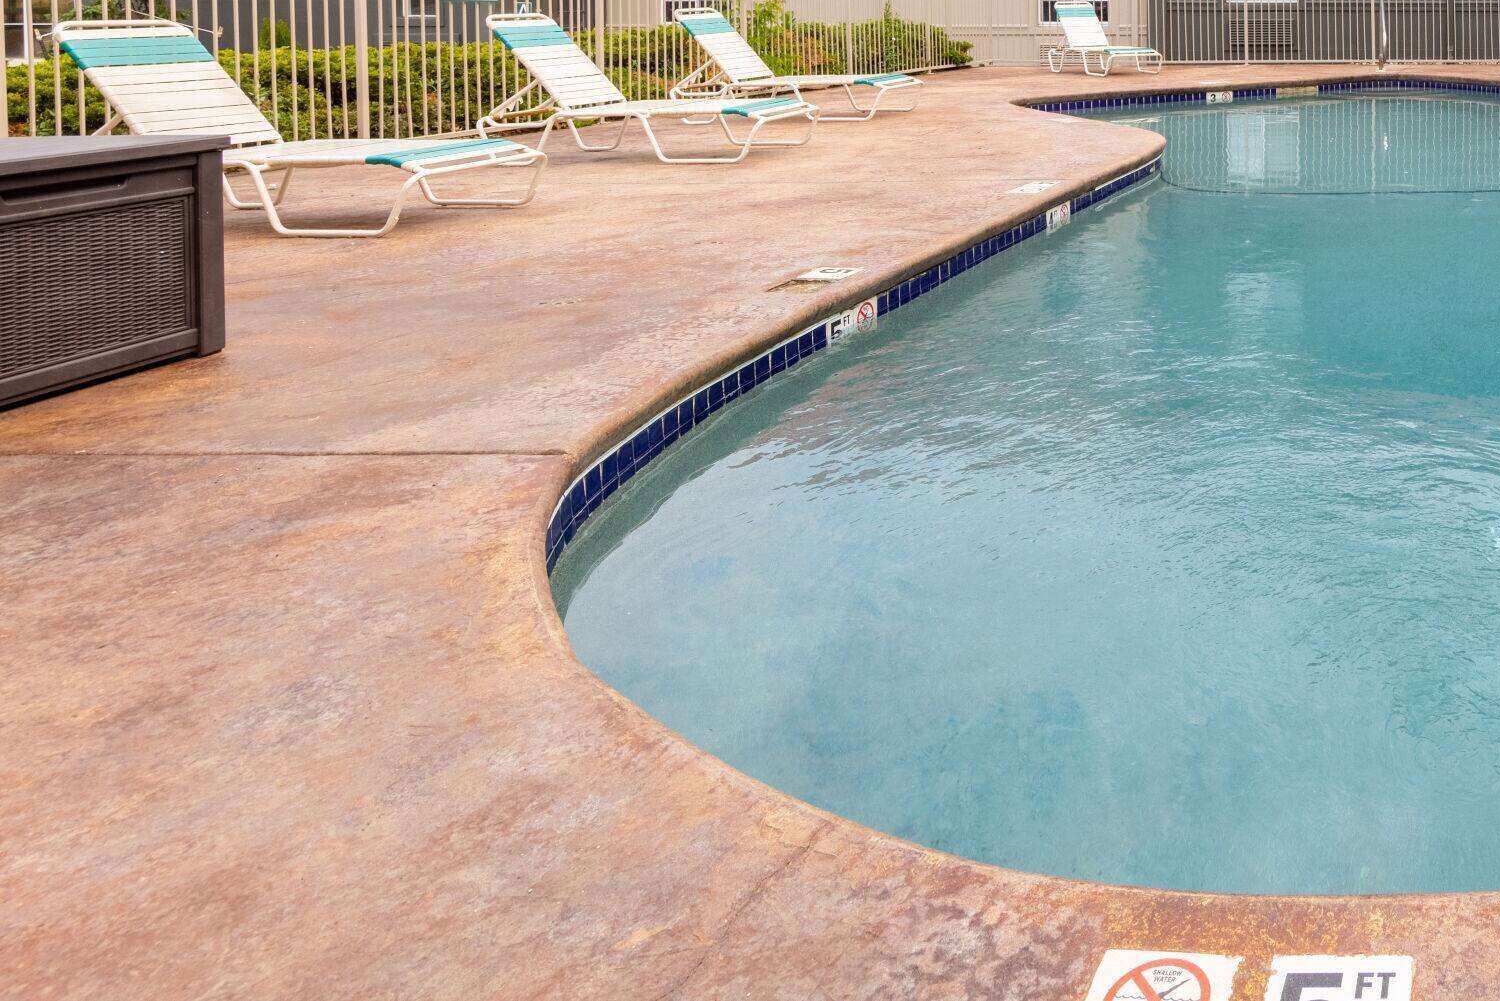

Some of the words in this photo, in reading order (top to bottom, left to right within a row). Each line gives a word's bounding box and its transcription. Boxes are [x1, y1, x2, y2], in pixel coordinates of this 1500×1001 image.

[1210, 93, 1216, 102] 3
[831, 319, 842, 340] 5
[843, 314, 850, 327] FT
[1355, 972, 1396, 999] FT
